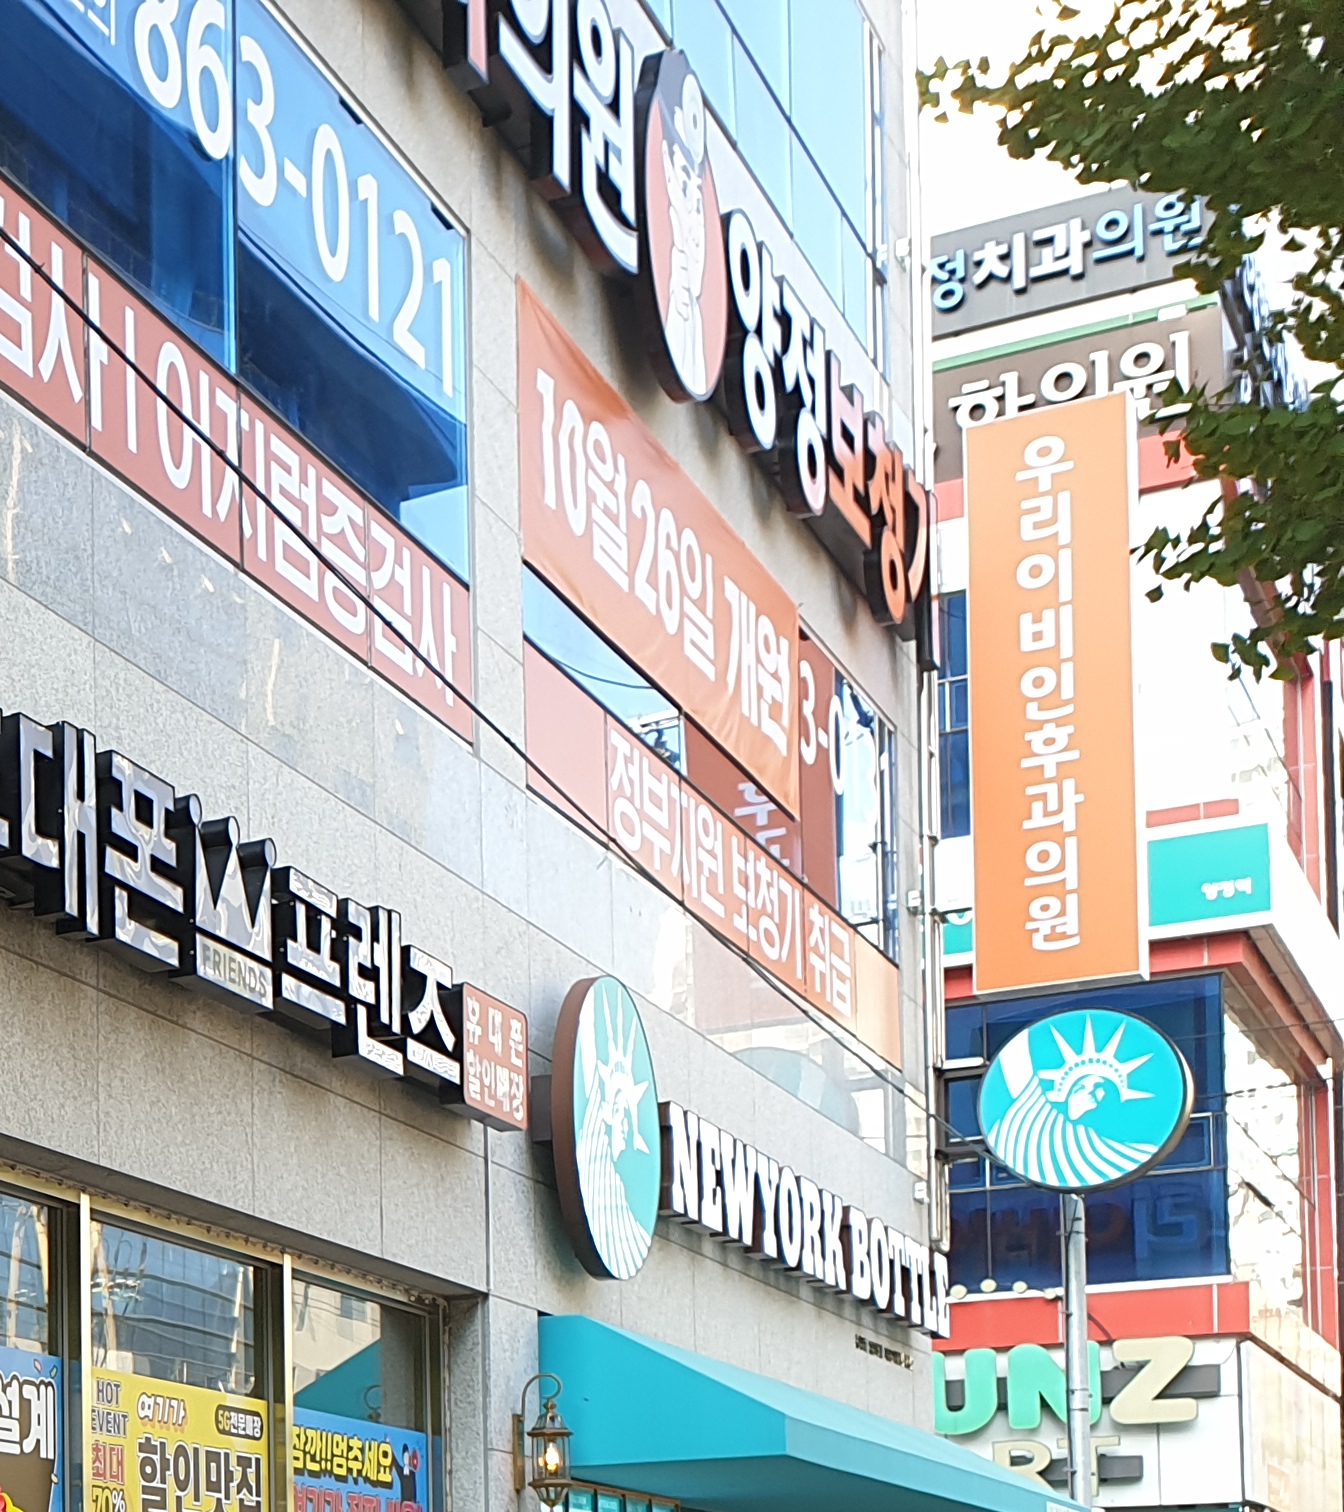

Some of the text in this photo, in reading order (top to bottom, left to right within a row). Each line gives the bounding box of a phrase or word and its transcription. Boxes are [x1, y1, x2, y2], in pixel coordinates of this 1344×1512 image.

[723, 574, 790, 758] 개원
[1015, 434, 1085, 952] 우리이비인후과의원
[200, 944, 269, 1001] FRIENDS
[280, 864, 462, 1086] 프렌즈
[466, 996, 524, 1068] 휴대폰
[848, 1205, 951, 1339] BOTTLE
[91, 1407, 129, 1438] EVENT
[96, 1378, 121, 1405] HOT
[138, 1393, 187, 1425] 여기가
[92, 1441, 125, 1484] 최대
